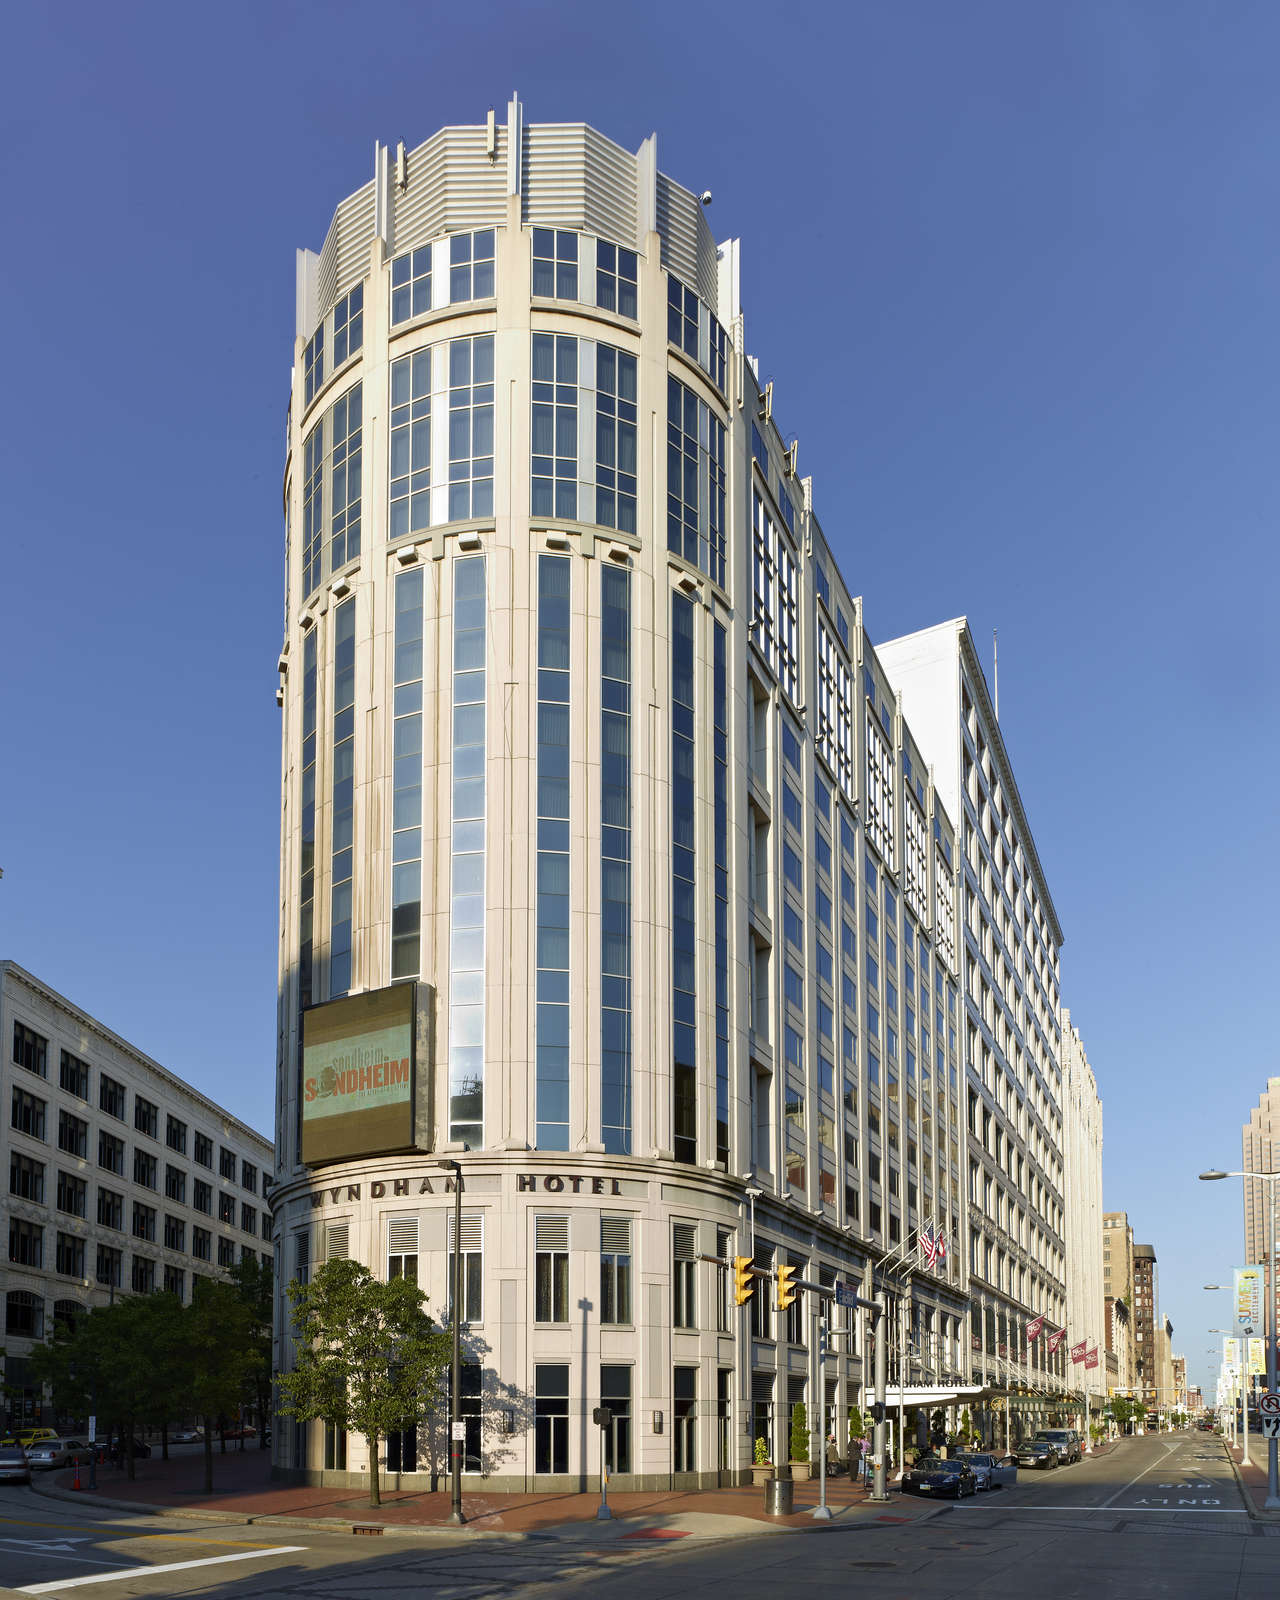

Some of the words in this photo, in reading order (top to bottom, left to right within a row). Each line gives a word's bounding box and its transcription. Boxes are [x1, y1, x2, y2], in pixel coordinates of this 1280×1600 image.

[305, 1056, 409, 1102] SNDHEIM
[311, 1176, 465, 1207] WYNDHAM
[518, 1175, 622, 1195] HOTEL
[887, 1380, 933, 1388] YNDHAM
